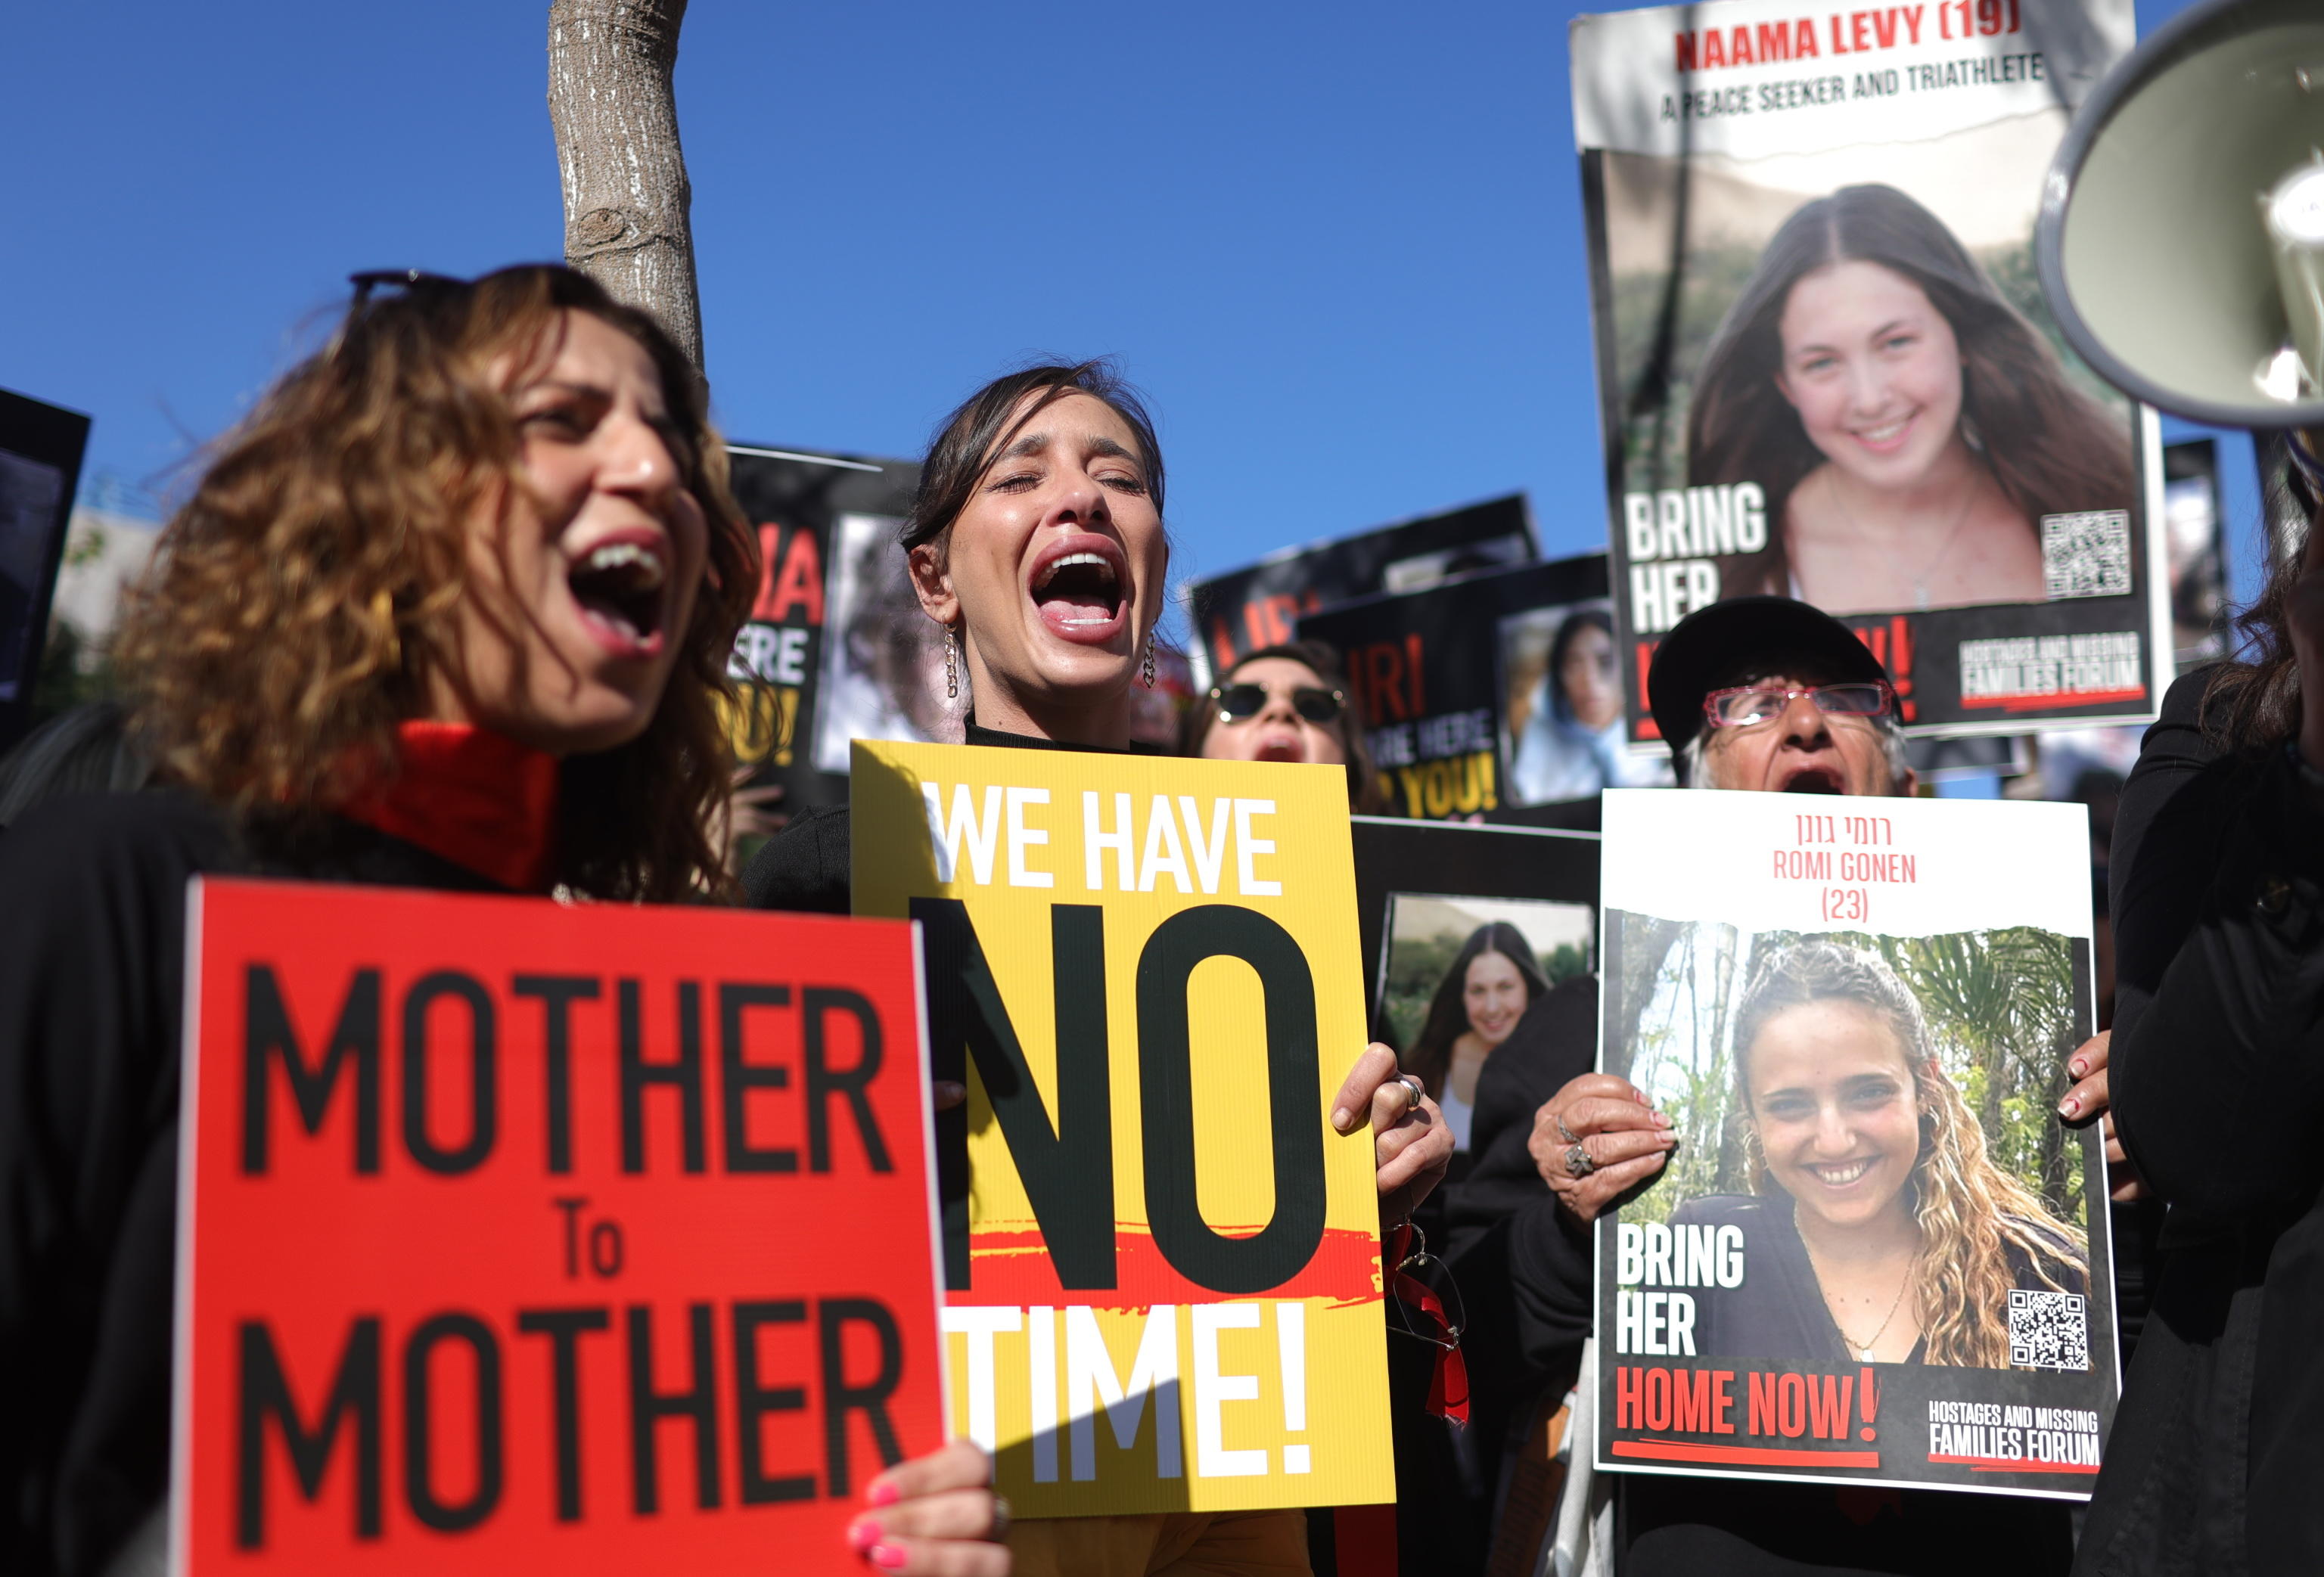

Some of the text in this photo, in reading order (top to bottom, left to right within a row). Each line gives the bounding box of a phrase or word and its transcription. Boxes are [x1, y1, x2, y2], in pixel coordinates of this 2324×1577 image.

[1674, 0, 2021, 72] NAAMA LEVY (19)
[1661, 53, 2045, 122] A PEACE SEEKER AND TRIATHLETE
[1624, 481, 1768, 561] BRING
[1630, 559, 1720, 635] HER
[1960, 656, 2141, 700] FAMILIES FORUM
[1400, 750, 1499, 820] YOU!
[921, 781, 1282, 896] WE HAVE
[1795, 815, 1892, 846] רומי גונן
[1773, 850, 1916, 883] ROMI GONEN
[1822, 886, 1869, 924] (23)
[238, 961, 896, 1177] MOTHER
[909, 896, 1327, 1294] NO
[1617, 1222, 1744, 1288] BRING
[1616, 1290, 1697, 1356] HER
[235, 1297, 908, 1553] MOTHER
[940, 1302, 1312, 1483] TIME!
[1617, 1366, 1881, 1442] HOME NOW!
[1928, 1400, 2099, 1433] HOSTAGES AND MISSING
[1929, 1423, 2101, 1466] FAMILIES FORUM
